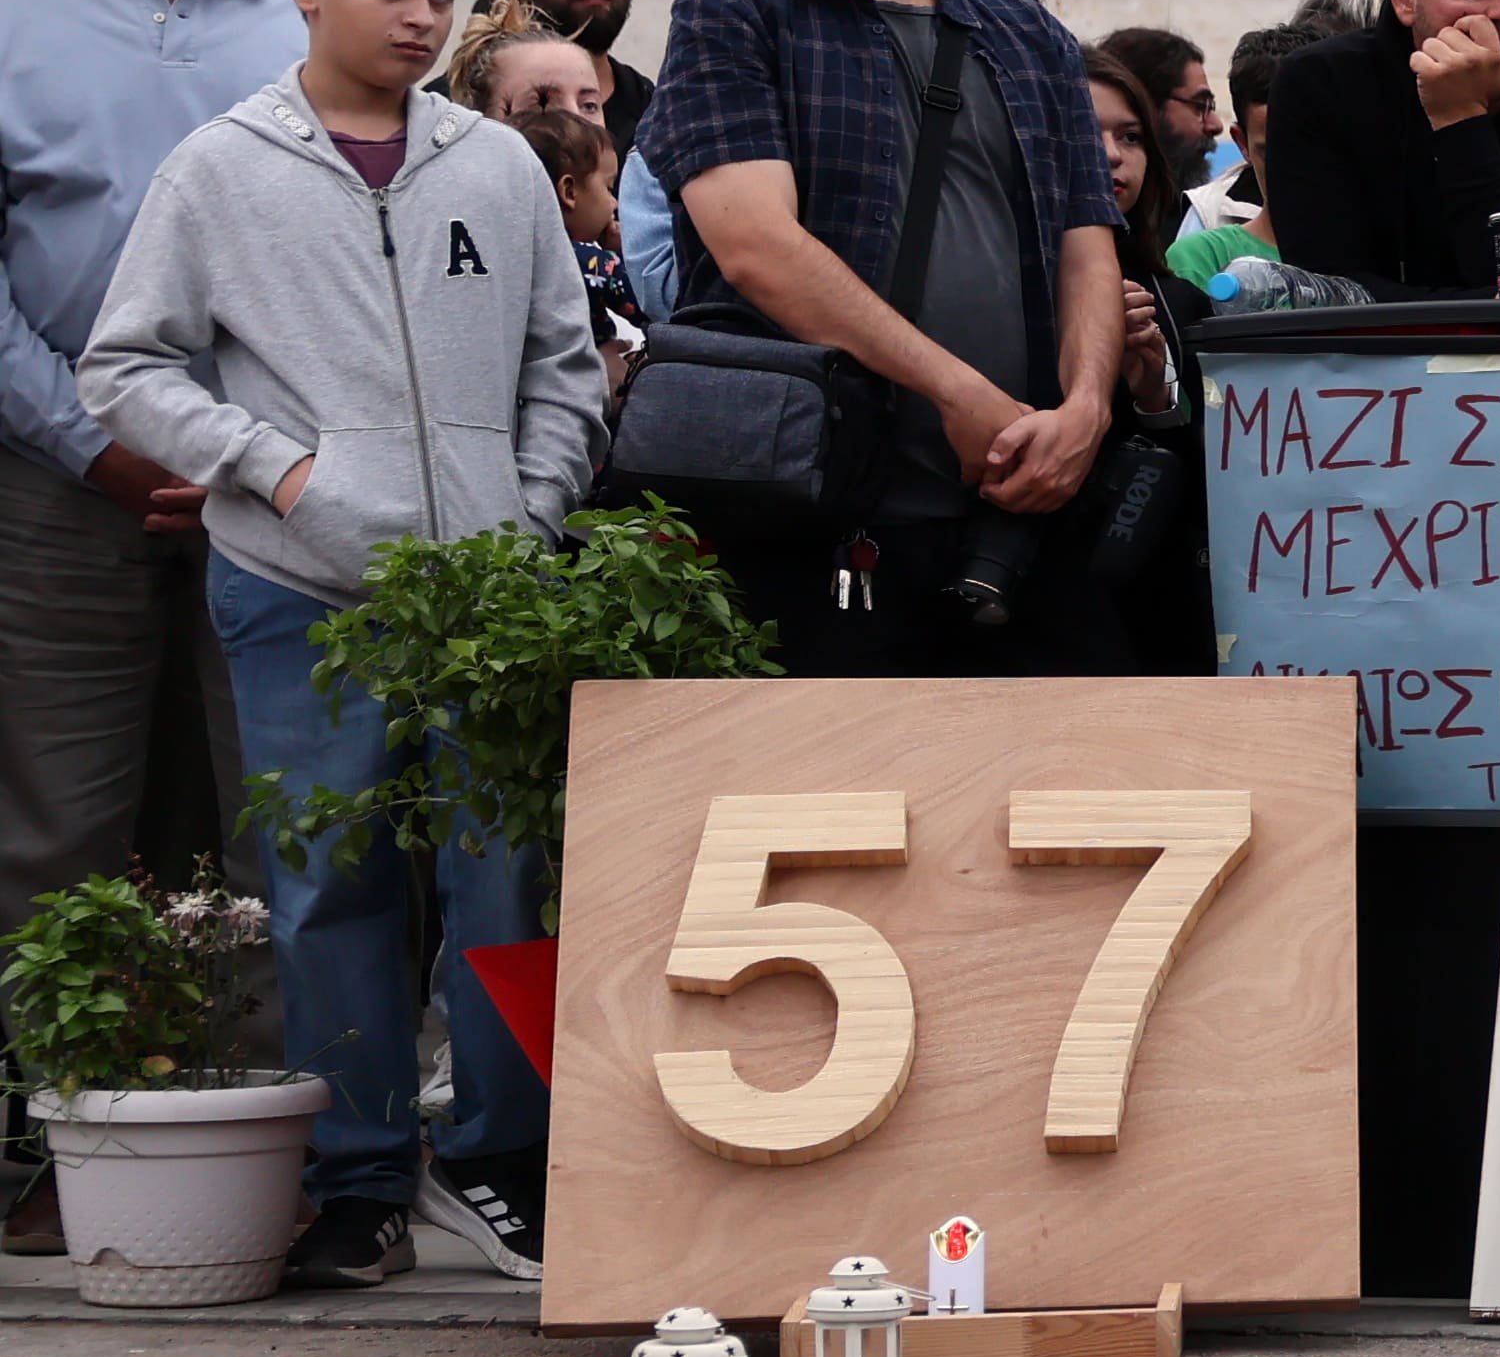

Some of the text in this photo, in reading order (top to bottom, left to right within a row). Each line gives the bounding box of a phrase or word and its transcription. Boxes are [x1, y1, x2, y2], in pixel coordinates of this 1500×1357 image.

[446, 219, 490, 279] A
[1219, 382, 1424, 477] ΜΑΖΙ
[1246, 499, 1500, 599] ΜΕΧΡΙ
[654, 790, 1254, 1166] 57
